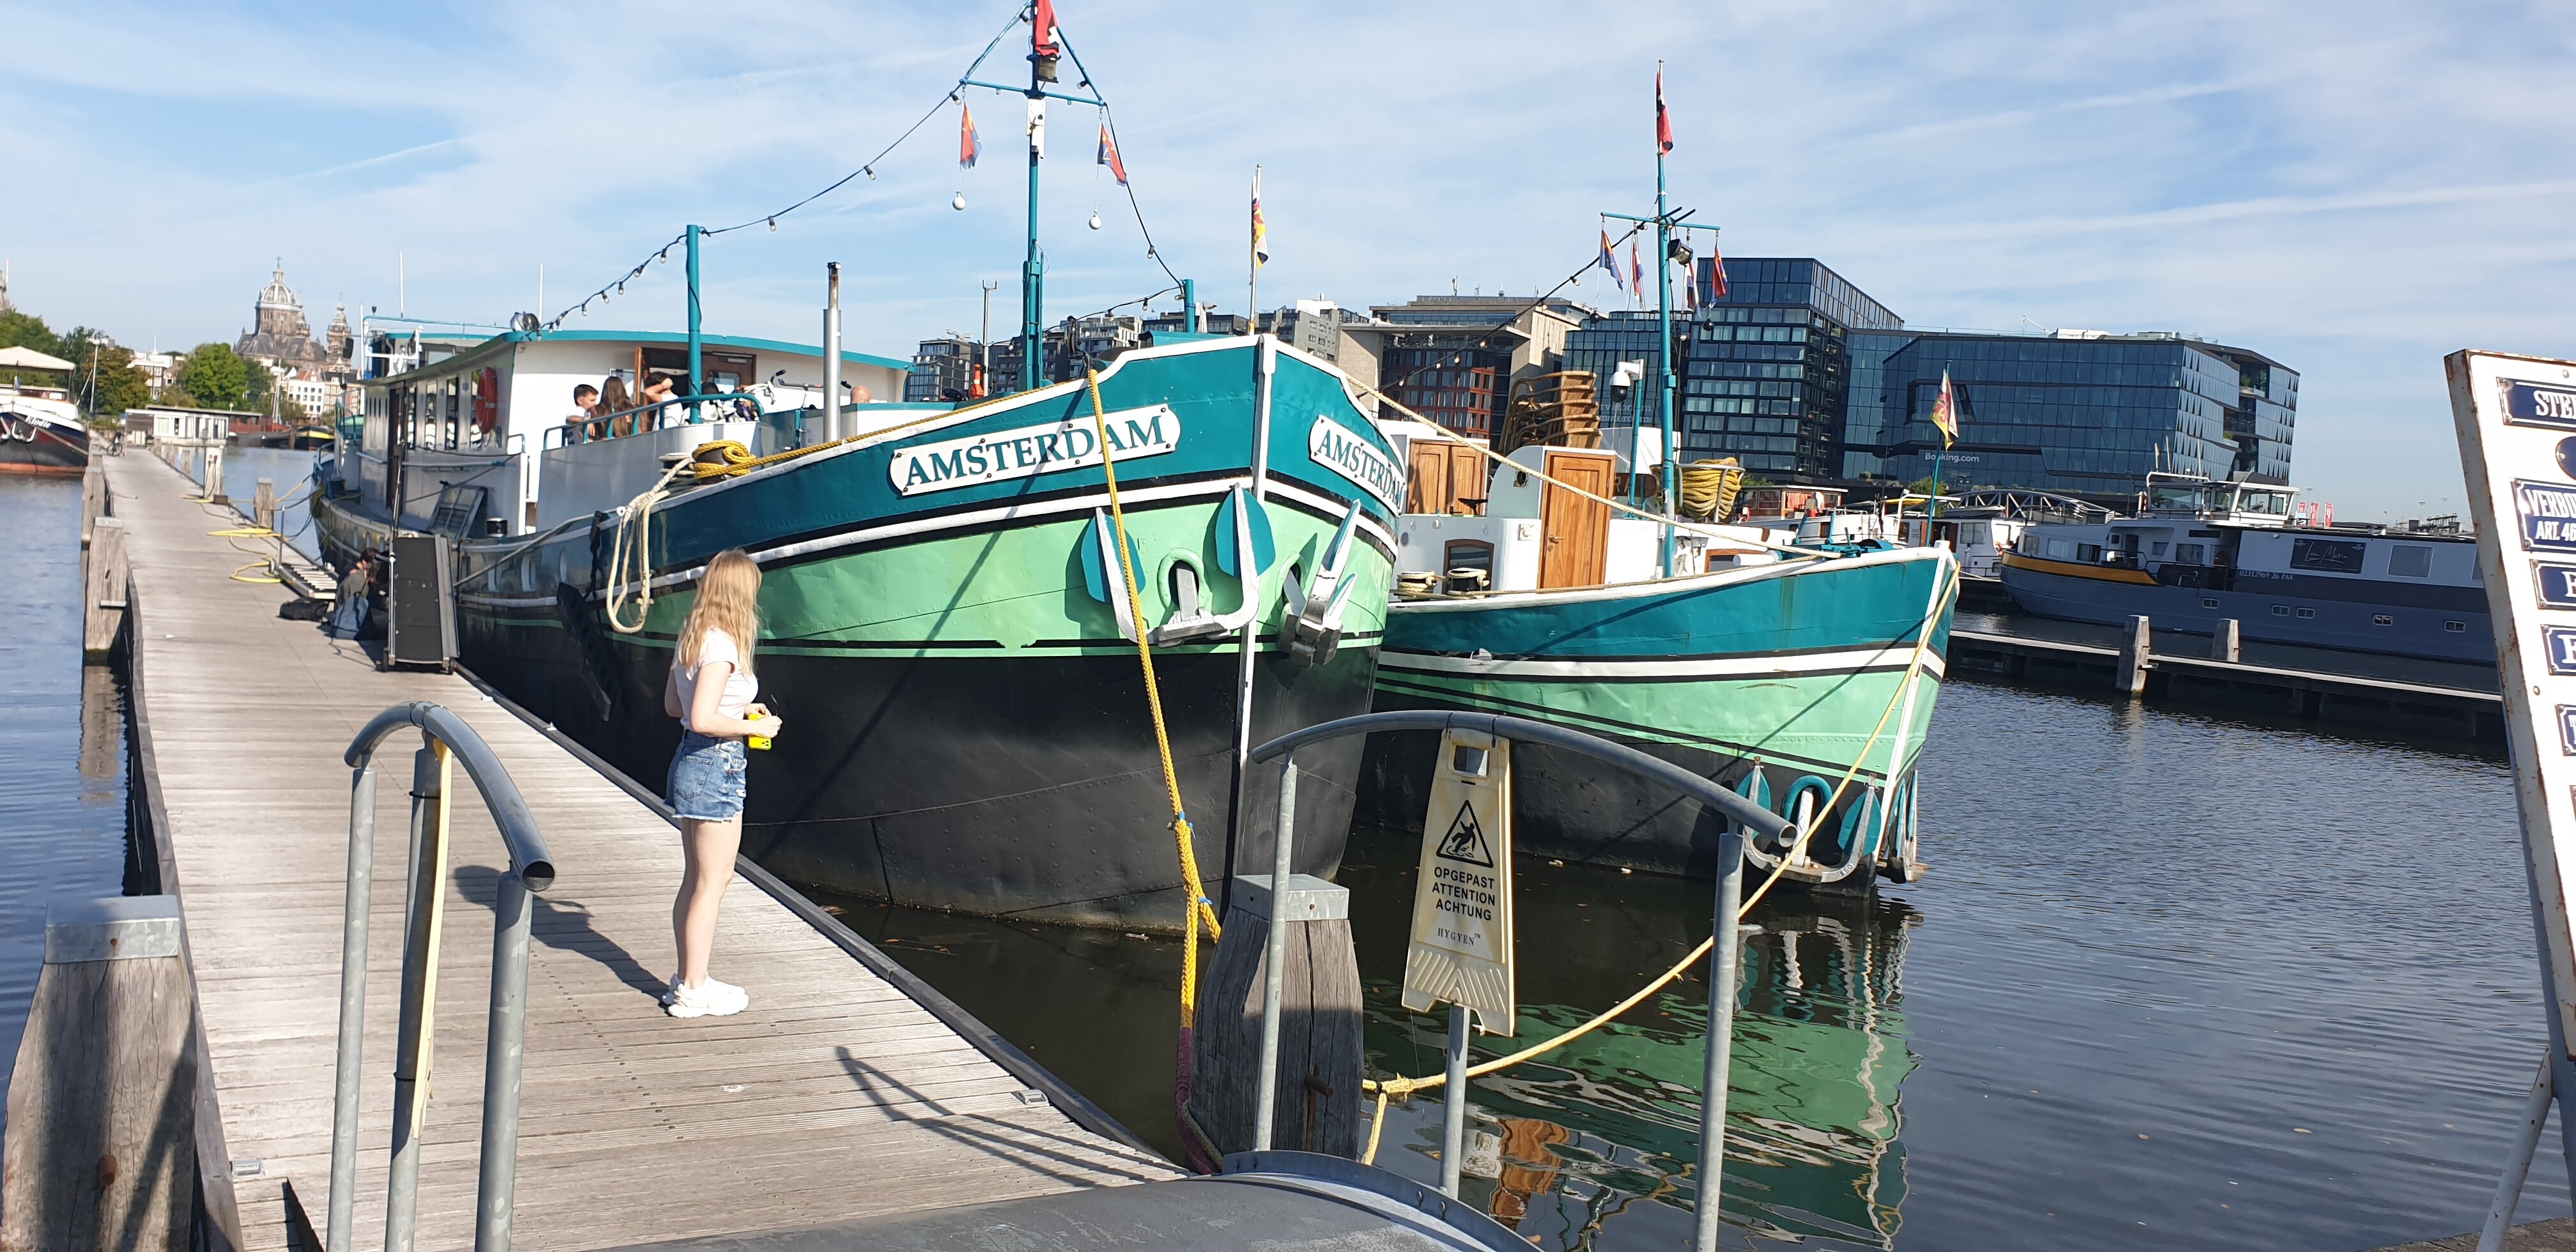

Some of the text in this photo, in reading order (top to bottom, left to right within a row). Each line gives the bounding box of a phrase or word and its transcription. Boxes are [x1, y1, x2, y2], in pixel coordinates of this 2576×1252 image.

[905, 415, 1166, 487] AMSTERDAM
[1925, 452, 1979, 463] Boking.com
[1317, 429, 1405, 510] AMSTERDAM
[2535, 521, 2561, 540] ART.
[1434, 866, 1495, 890] OPGEPAST
[1432, 882, 1496, 906] ATTENTION
[1436, 898, 1491, 920] ACHTUNG
